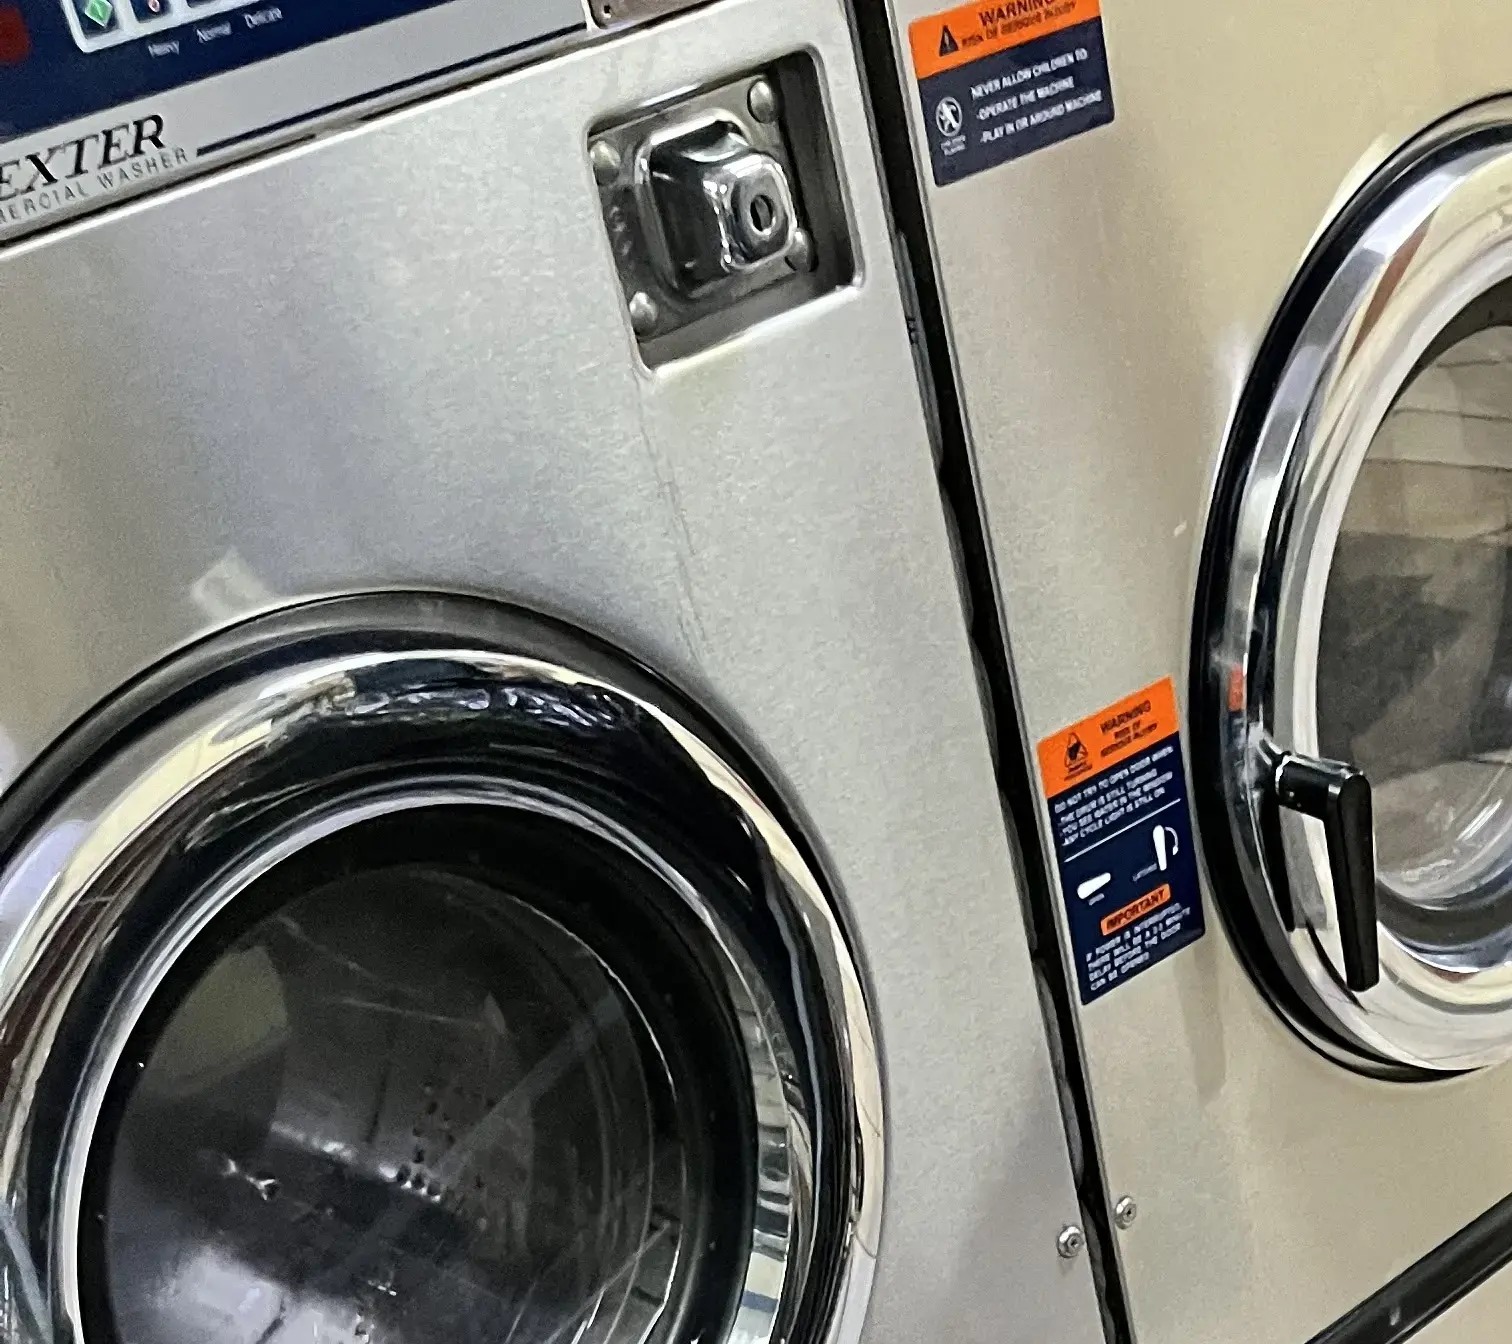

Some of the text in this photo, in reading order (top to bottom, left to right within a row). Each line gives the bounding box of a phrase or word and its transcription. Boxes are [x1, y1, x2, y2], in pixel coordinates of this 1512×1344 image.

[978, 0, 1054, 27] WARNIN
[970, 47, 1088, 100] NEVER ALLOW CHILDREN TO
[1019, 89, 1036, 106] THE
[1036, 75, 1075, 98] MACHINE
[97, 147, 189, 190] WASHER
[1100, 700, 1151, 735] WARNING
[1106, 888, 1165, 931] IMPORTANT
